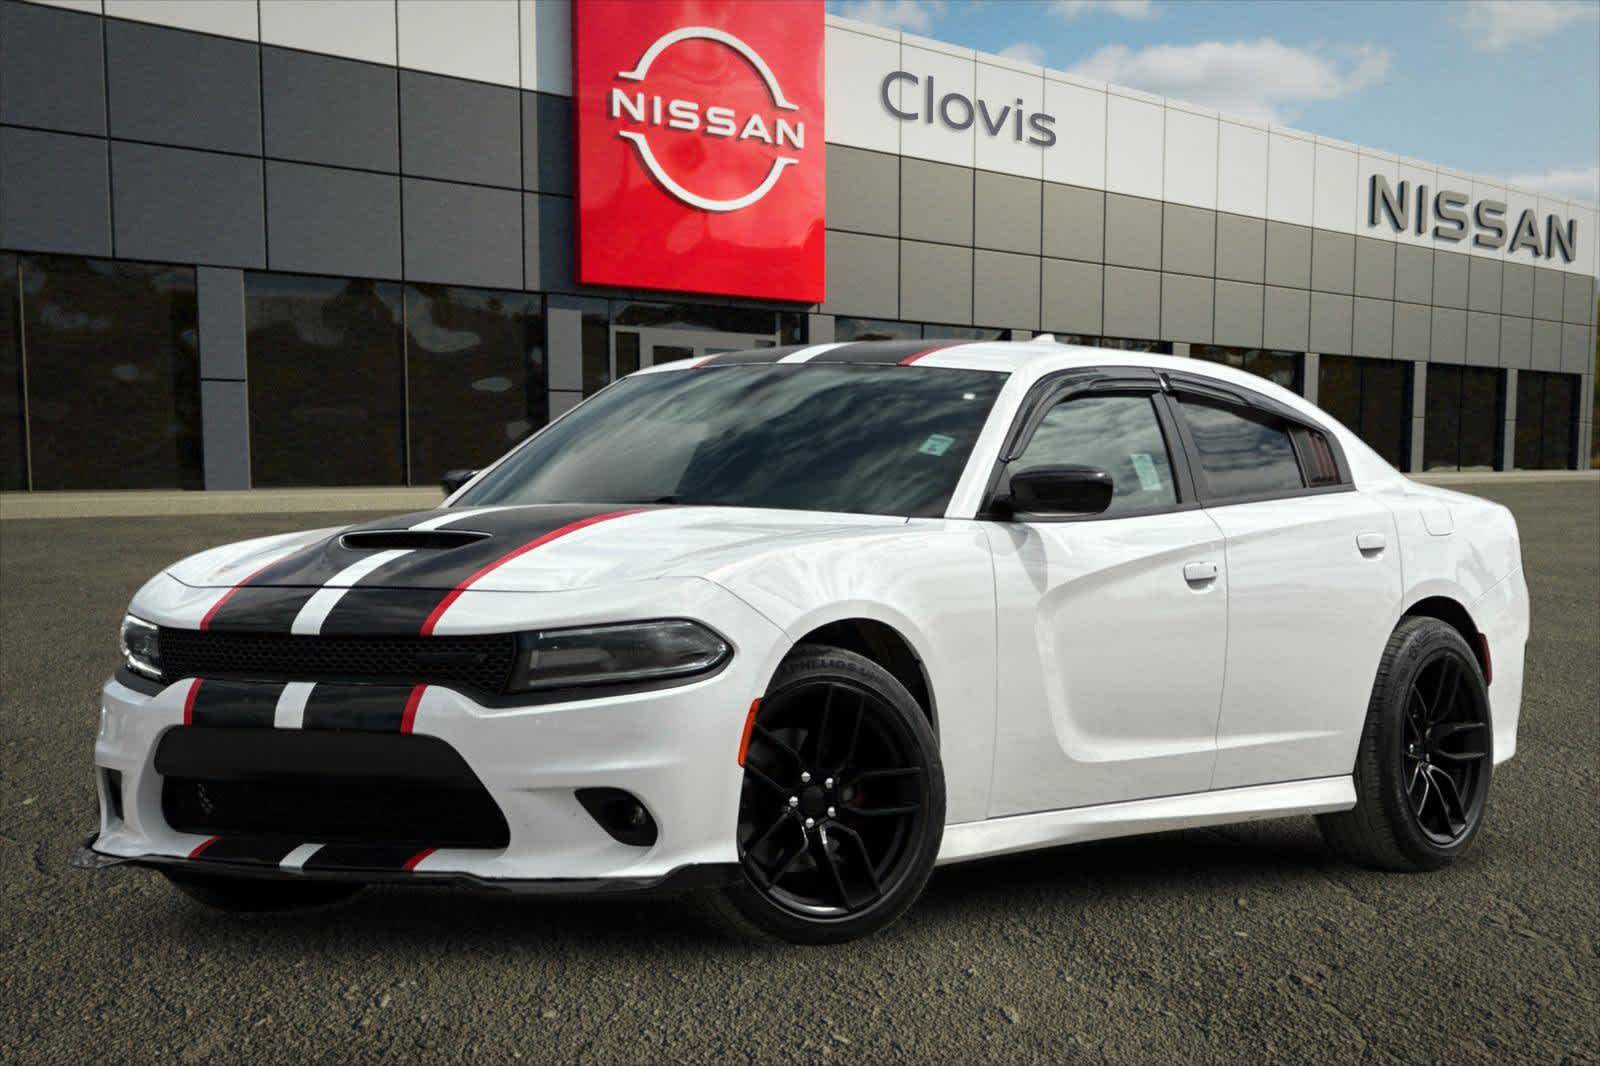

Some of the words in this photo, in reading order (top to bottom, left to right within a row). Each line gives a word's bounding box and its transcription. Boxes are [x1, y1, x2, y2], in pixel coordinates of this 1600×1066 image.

[611, 87, 805, 150] NISSAN
[880, 70, 1057, 147] Clovis
[1368, 173, 1578, 263] NISSAN
